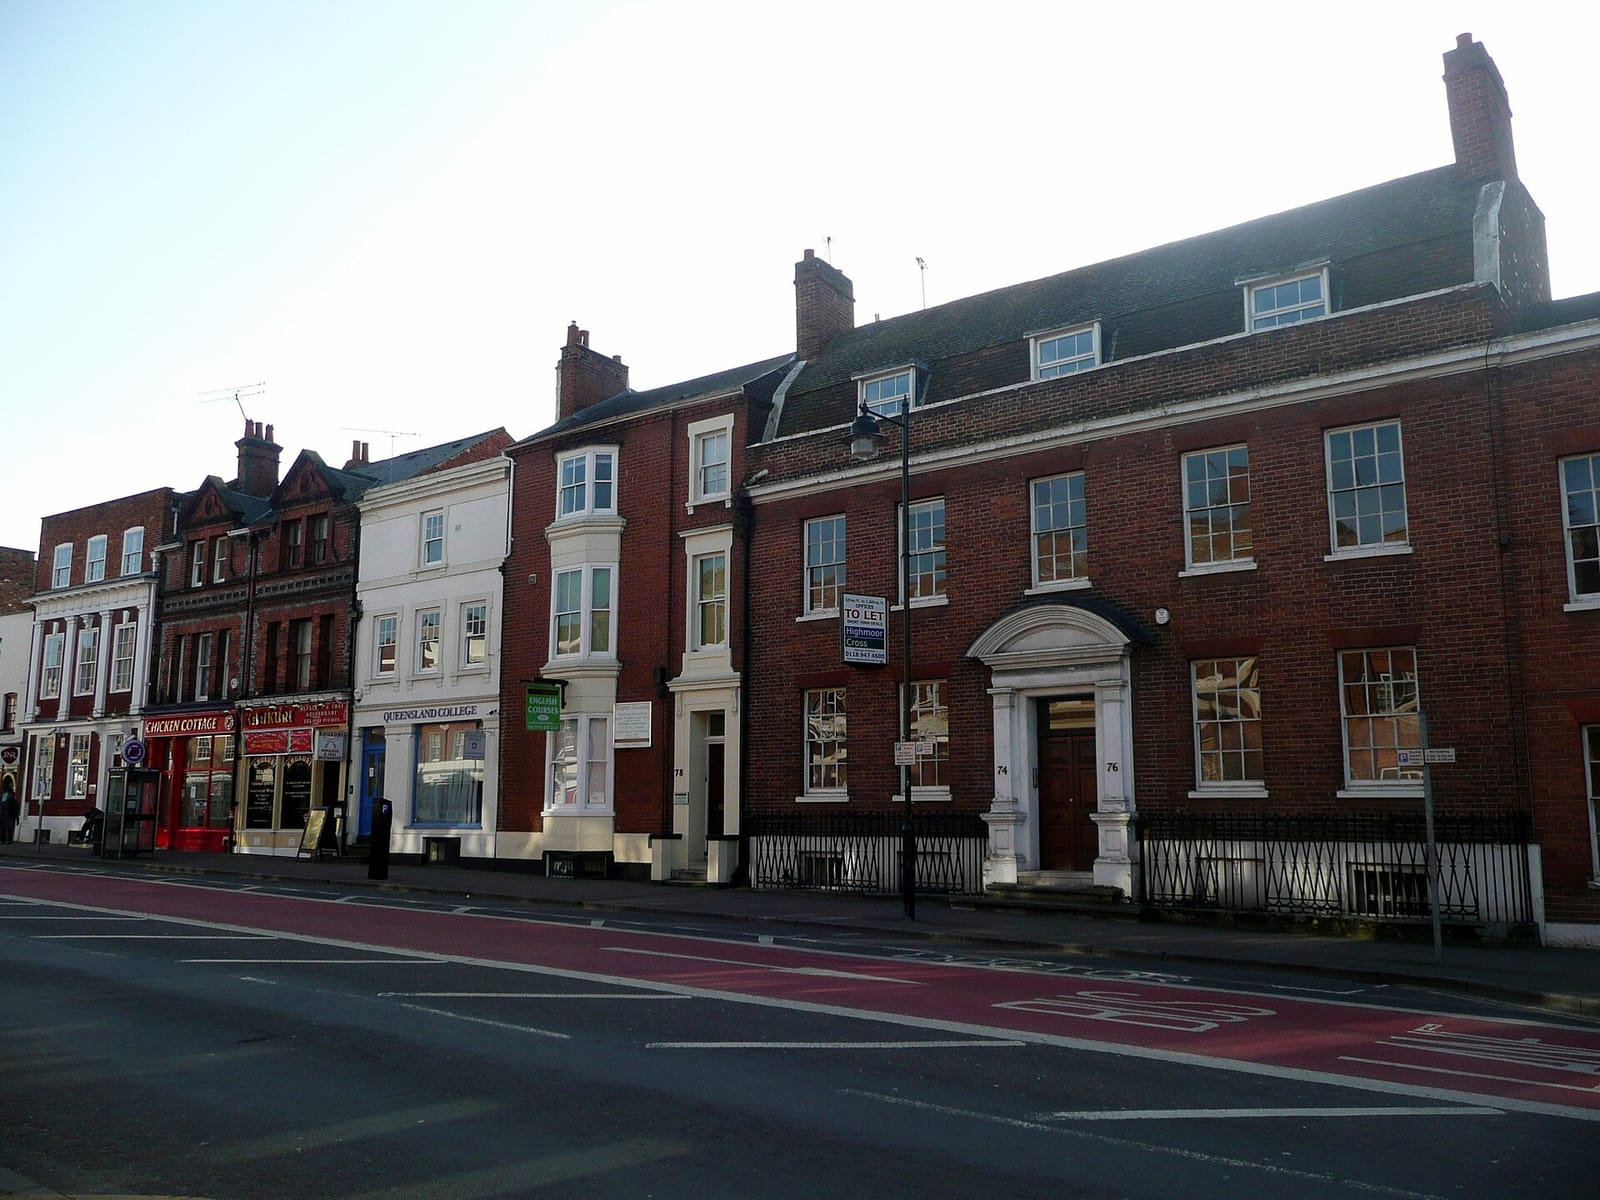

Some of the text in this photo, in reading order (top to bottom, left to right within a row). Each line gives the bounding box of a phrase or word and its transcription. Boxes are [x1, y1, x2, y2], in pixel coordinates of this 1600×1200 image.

[845, 608, 884, 621] TO LET
[846, 627, 883, 638] Highmoor
[846, 638, 868, 648] Cross
[529, 696, 557, 705] ENGLISH
[383, 705, 478, 723] QUEENSLAND COLLEGE
[527, 705, 559, 714] COURSES
[145, 717, 217, 733] CHICKEN COTTAGE
[675, 768, 684, 777] 78
[997, 765, 1008, 775] 74
[1107, 762, 1119, 773] 76
[387, 804, 393, 814] P
[989, 990, 1278, 1033] BUS
